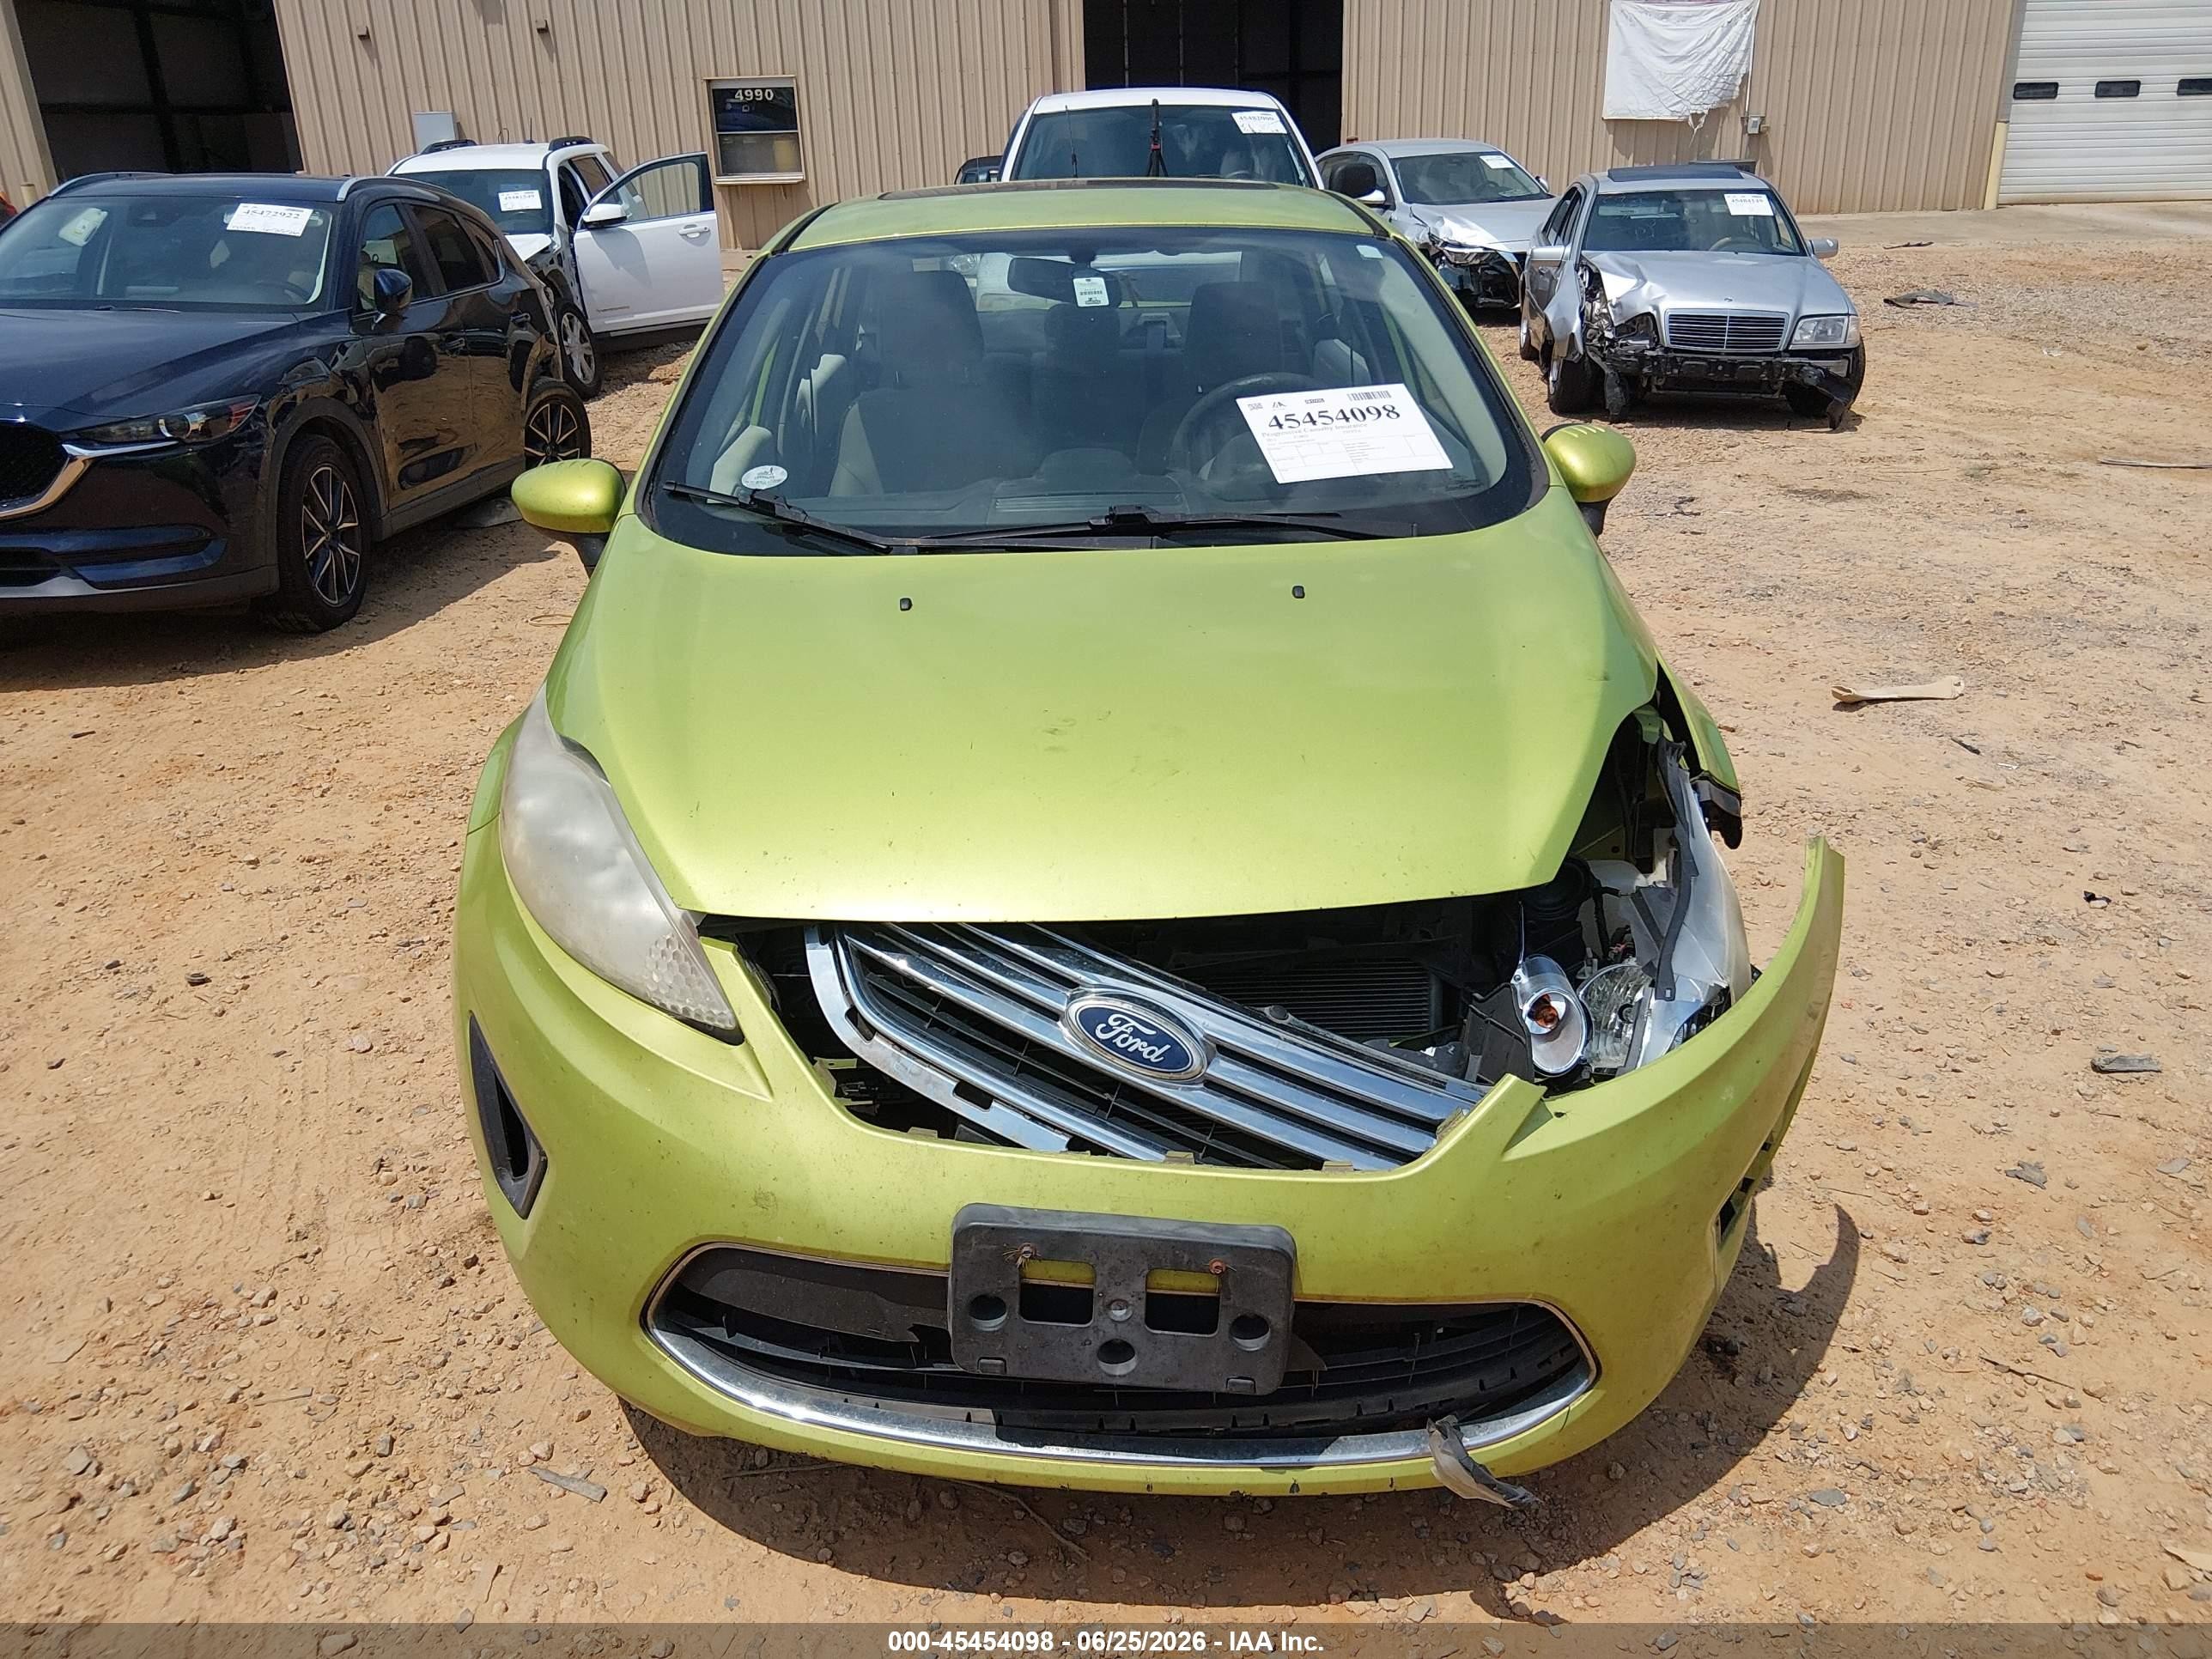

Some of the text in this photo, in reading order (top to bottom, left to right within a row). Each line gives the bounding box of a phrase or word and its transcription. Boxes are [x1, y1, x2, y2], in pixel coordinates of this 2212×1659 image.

[735, 88, 775, 101] 4990
[1268, 404, 1401, 430] 45454098
[1096, 1013, 1171, 1064] Ford
